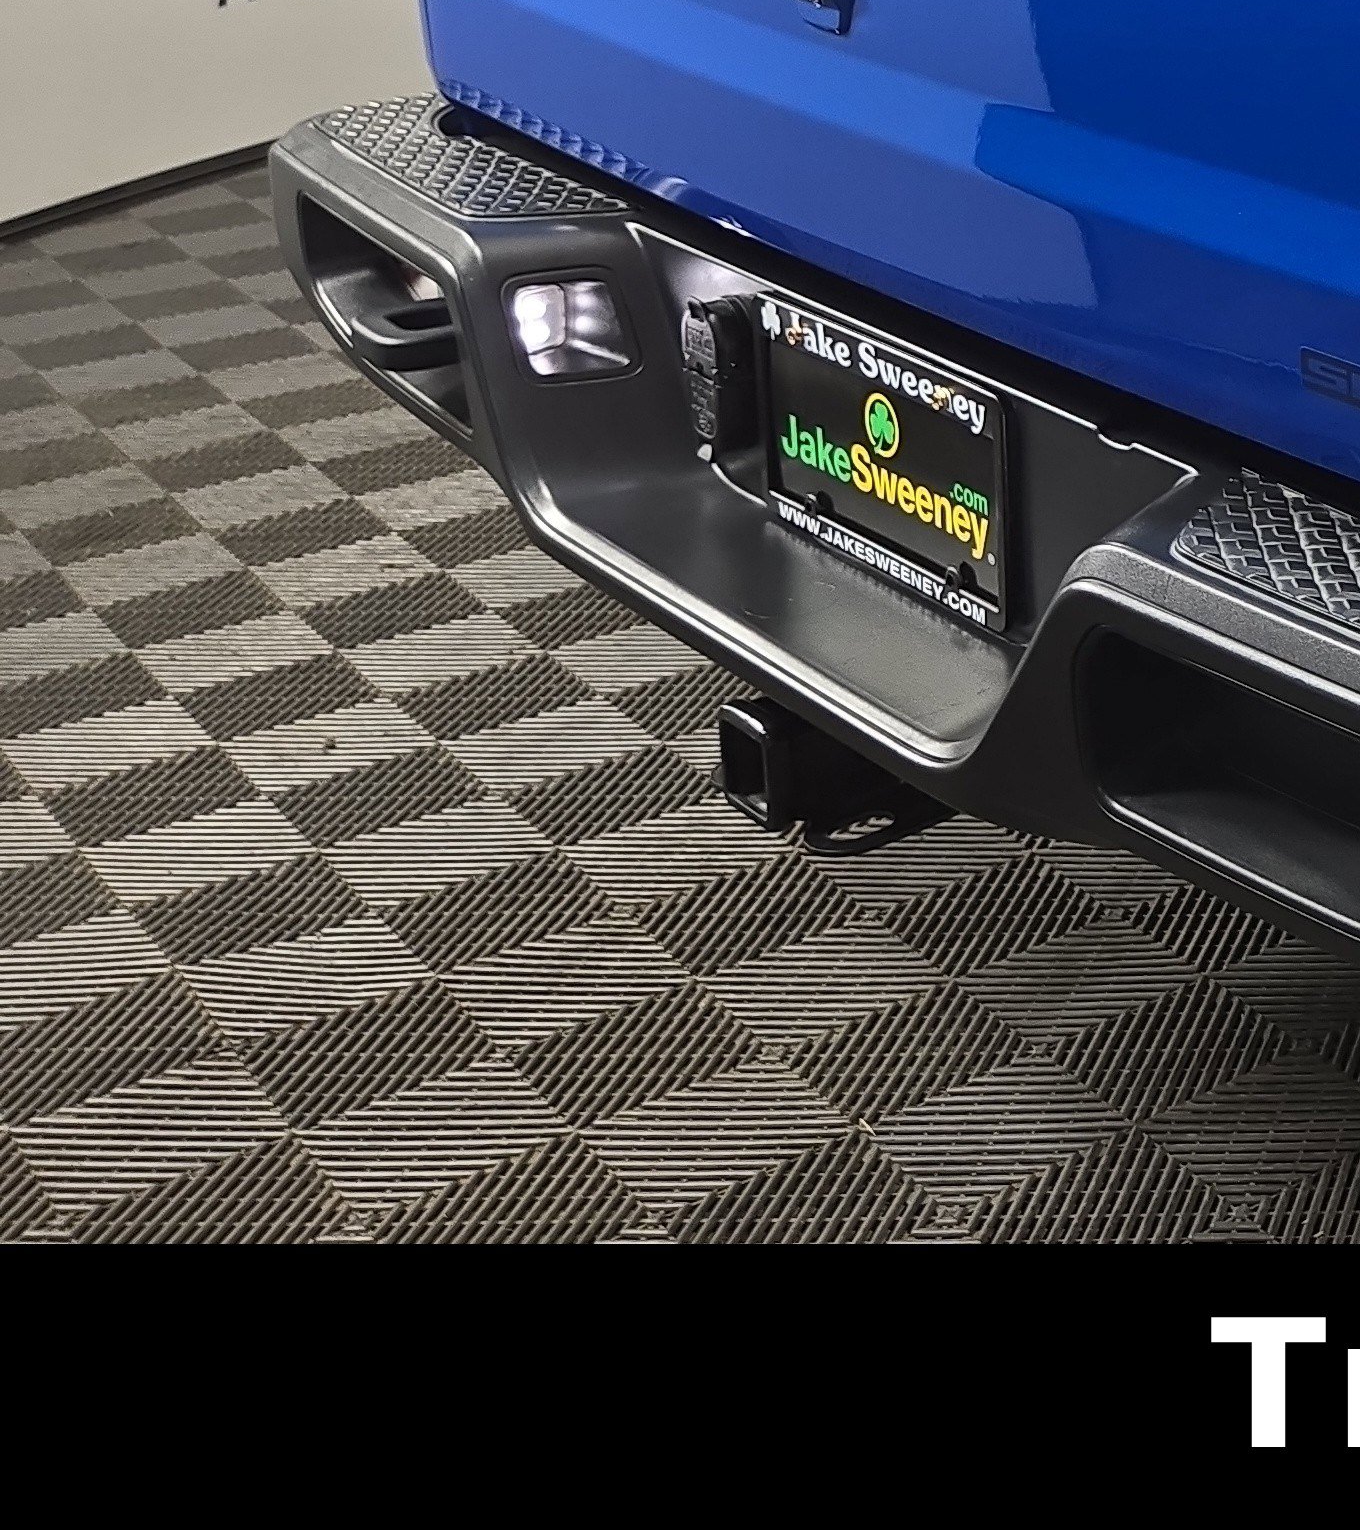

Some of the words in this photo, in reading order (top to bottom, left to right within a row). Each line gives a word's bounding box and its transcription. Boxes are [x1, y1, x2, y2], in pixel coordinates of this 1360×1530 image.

[785, 311, 852, 368] Jake
[858, 342, 986, 436] Sweeney
[776, 500, 988, 627] WWW.JAKESWEENEY.COM
